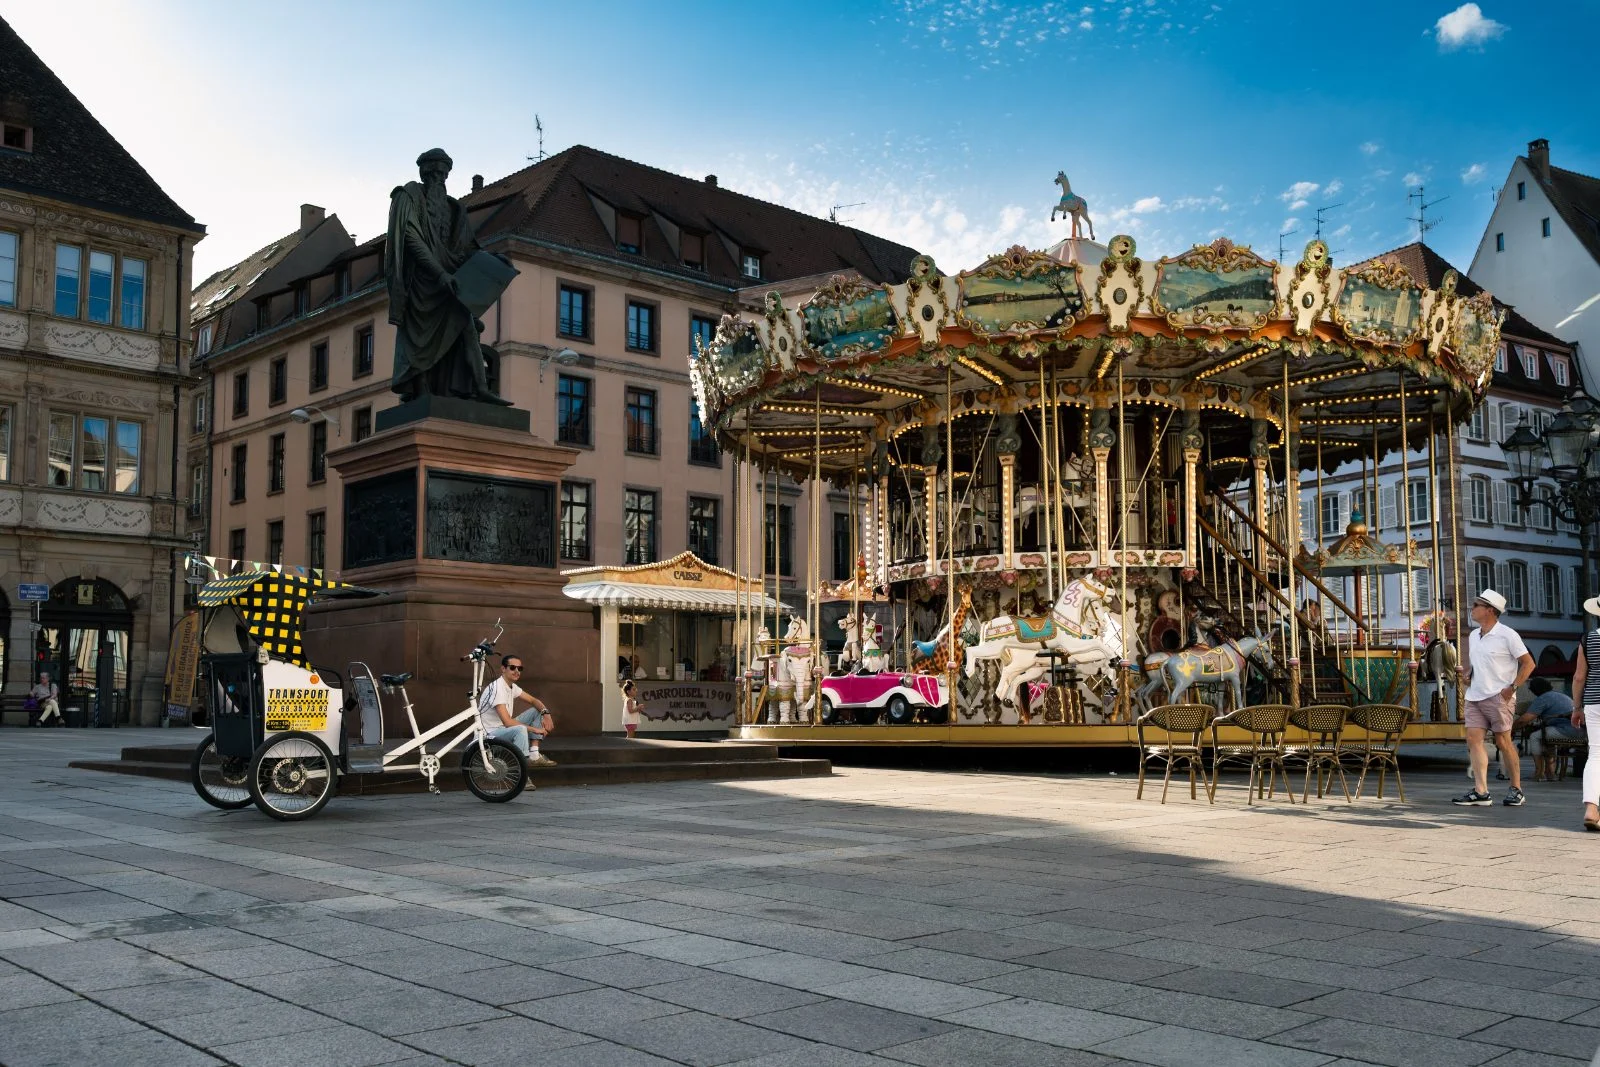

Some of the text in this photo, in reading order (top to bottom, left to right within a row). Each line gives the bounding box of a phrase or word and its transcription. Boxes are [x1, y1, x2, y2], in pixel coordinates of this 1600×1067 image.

[673, 571, 702, 581] CAISSE
[183, 620, 193, 644] CHOIX
[178, 645, 189, 671] GRAND
[176, 674, 186, 692] PLUS
[269, 689, 329, 699] TRANSPORT
[641, 688, 732, 702] CARROUSEL 1900
